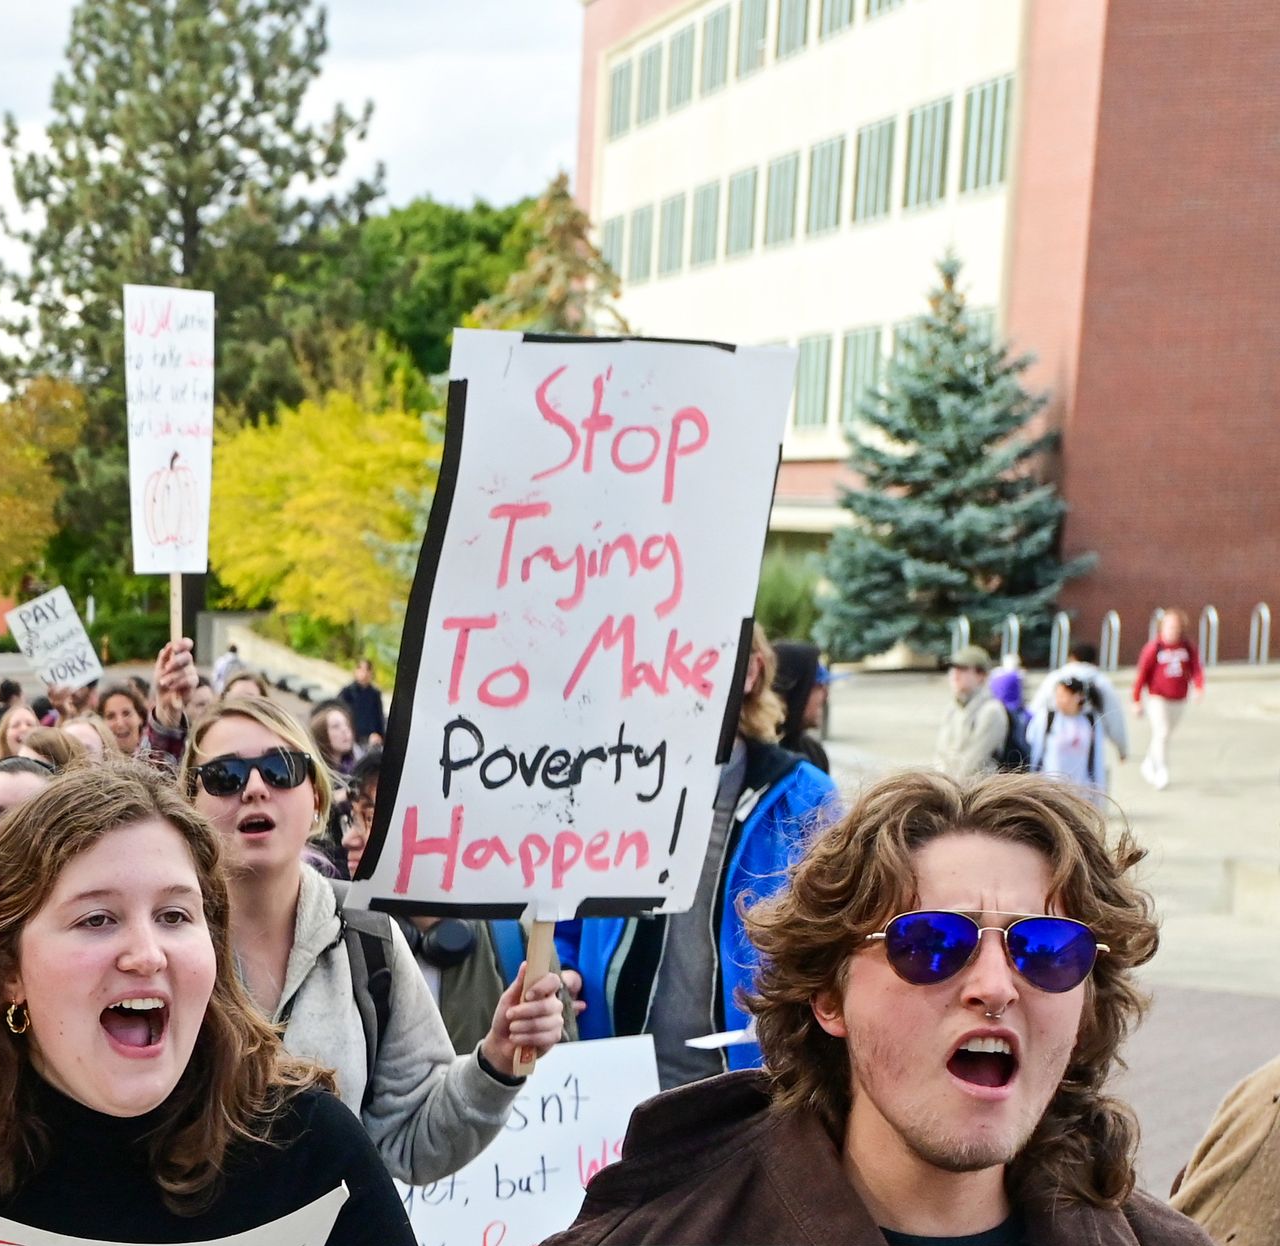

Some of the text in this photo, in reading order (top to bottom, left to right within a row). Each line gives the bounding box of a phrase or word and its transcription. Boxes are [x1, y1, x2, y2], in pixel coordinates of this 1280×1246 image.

[531, 364, 709, 504] Stop
[489, 501, 684, 619] Trying
[19, 597, 60, 631] PAY
[442, 614, 721, 708] To Make
[440, 717, 667, 801] Poverty
[495, 1155, 560, 1200] but
